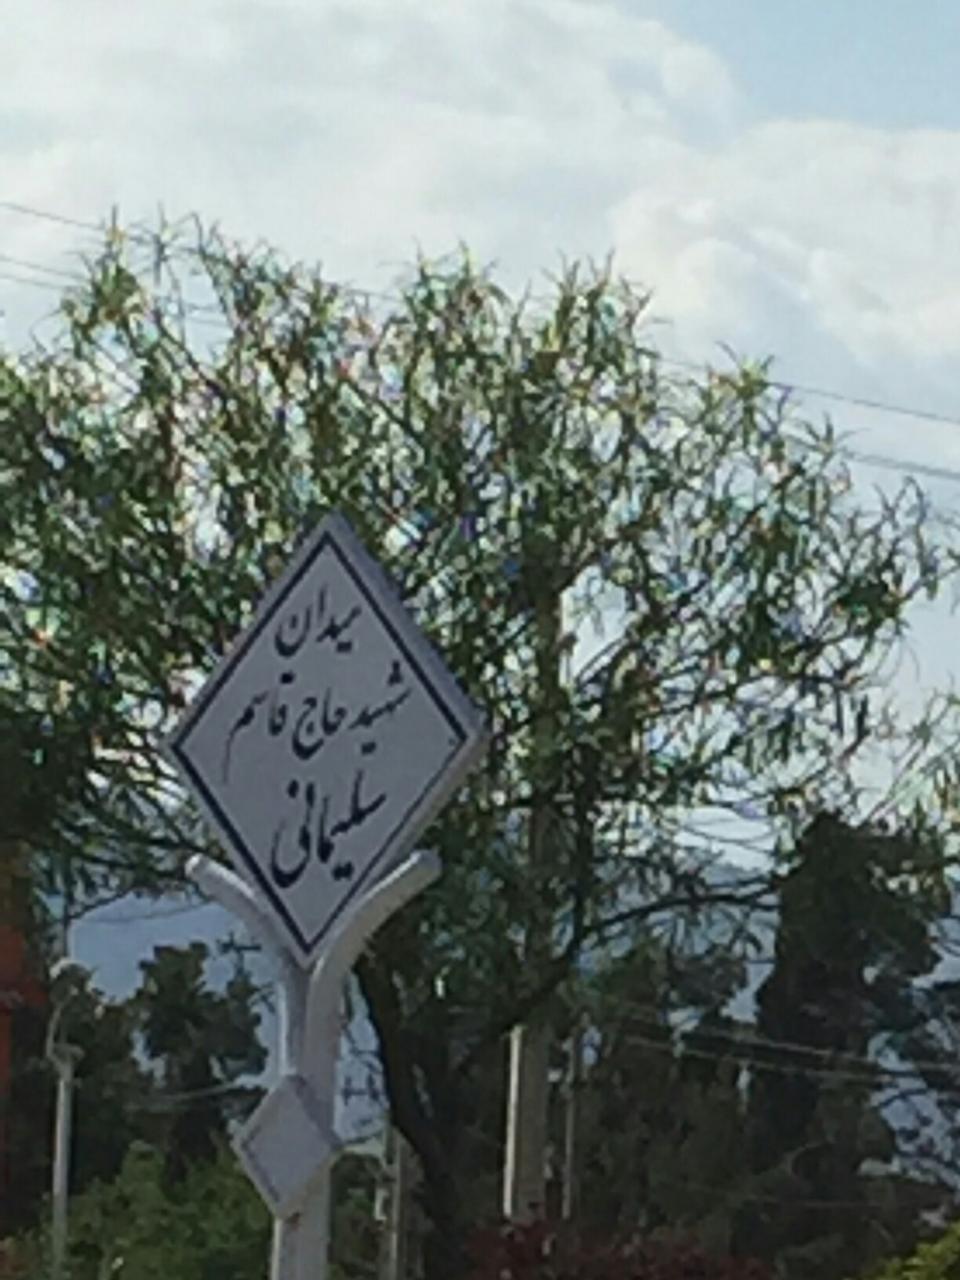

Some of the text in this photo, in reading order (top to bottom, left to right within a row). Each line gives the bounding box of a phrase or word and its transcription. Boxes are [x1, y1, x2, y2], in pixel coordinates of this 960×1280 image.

[274, 584, 362, 657] میدان
[221, 660, 411, 784] شهید حاج قاسم
[270, 769, 387, 888] سلیمانی
